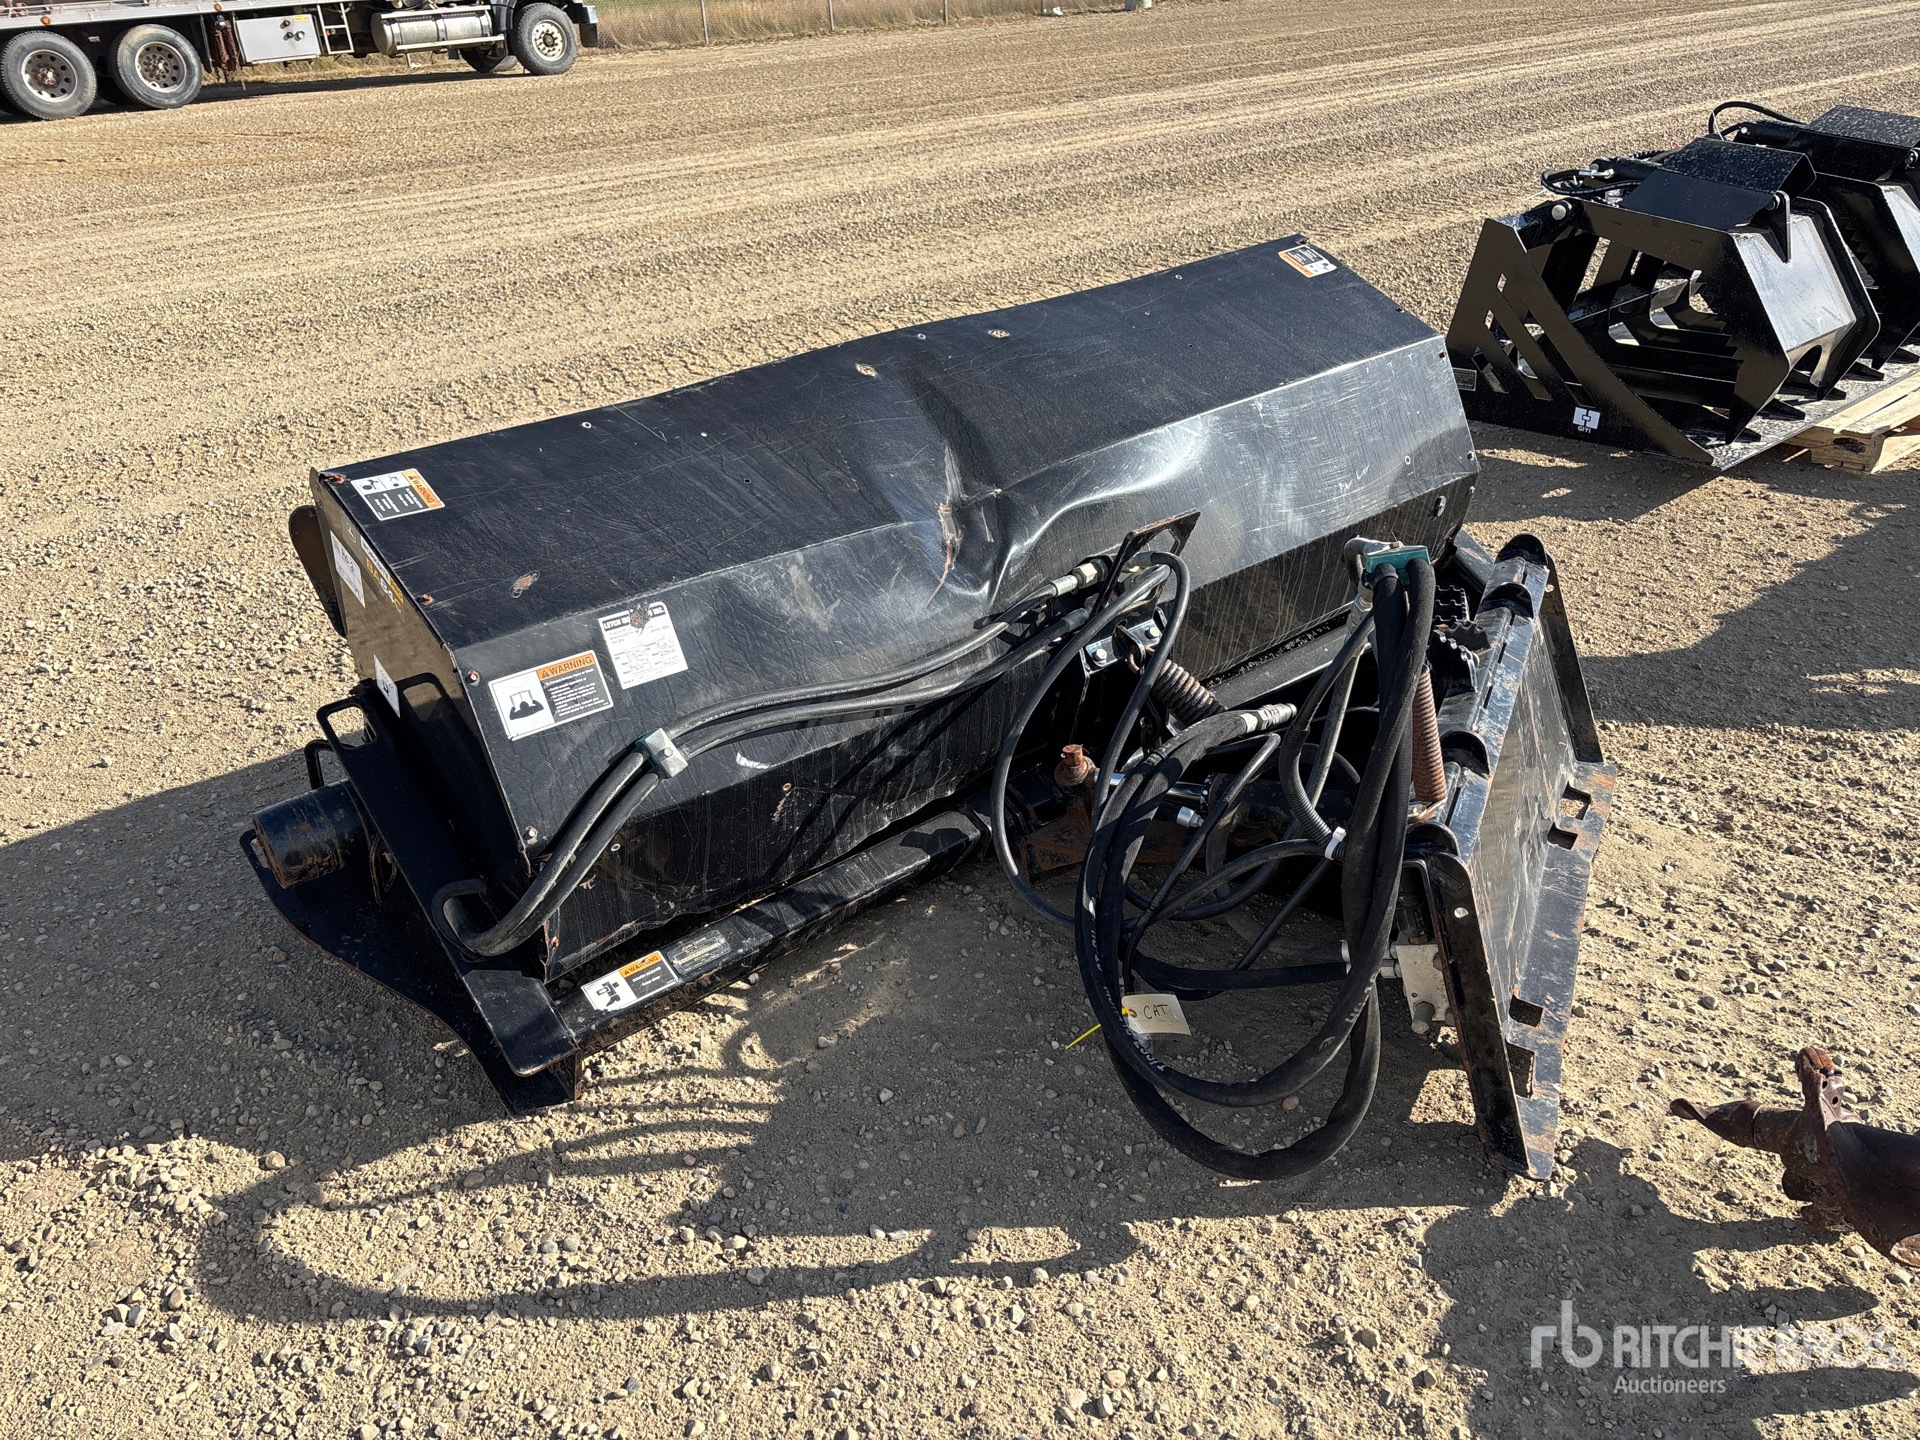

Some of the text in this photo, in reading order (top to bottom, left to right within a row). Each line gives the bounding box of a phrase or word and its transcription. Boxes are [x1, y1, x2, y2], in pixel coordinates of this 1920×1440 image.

[1577, 425, 1592, 434] GIYI
[411, 479, 435, 503] WARNING
[548, 655, 593, 675] WARNING
[1143, 1004, 1168, 1019] CAT
